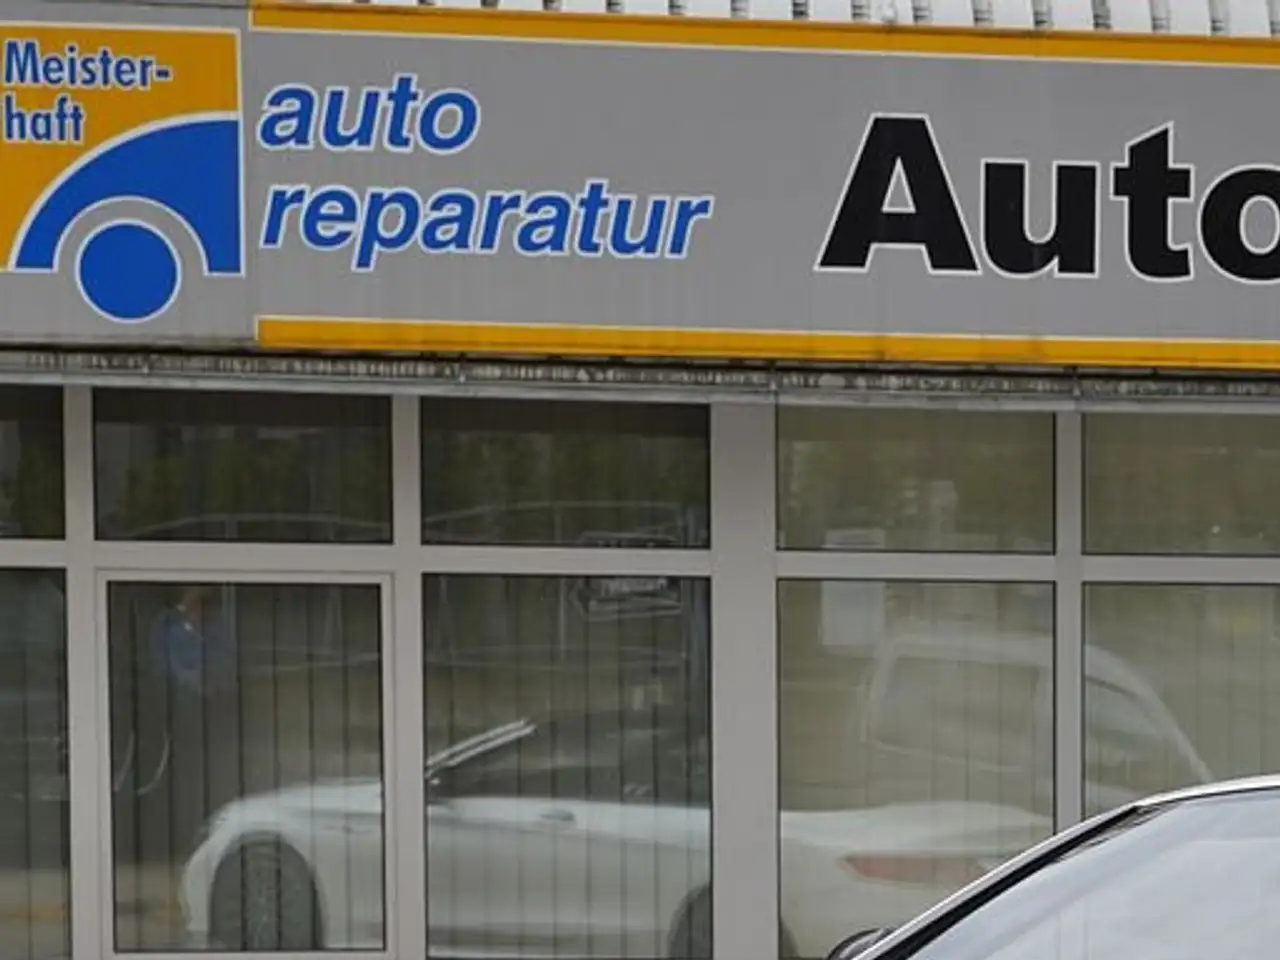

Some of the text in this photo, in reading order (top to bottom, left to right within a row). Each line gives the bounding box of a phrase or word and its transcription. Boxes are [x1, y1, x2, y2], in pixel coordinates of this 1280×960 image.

[4, 41, 171, 88] Meister-
[4, 94, 84, 142] haft
[259, 74, 480, 153] auto
[260, 180, 713, 271] reparatur
